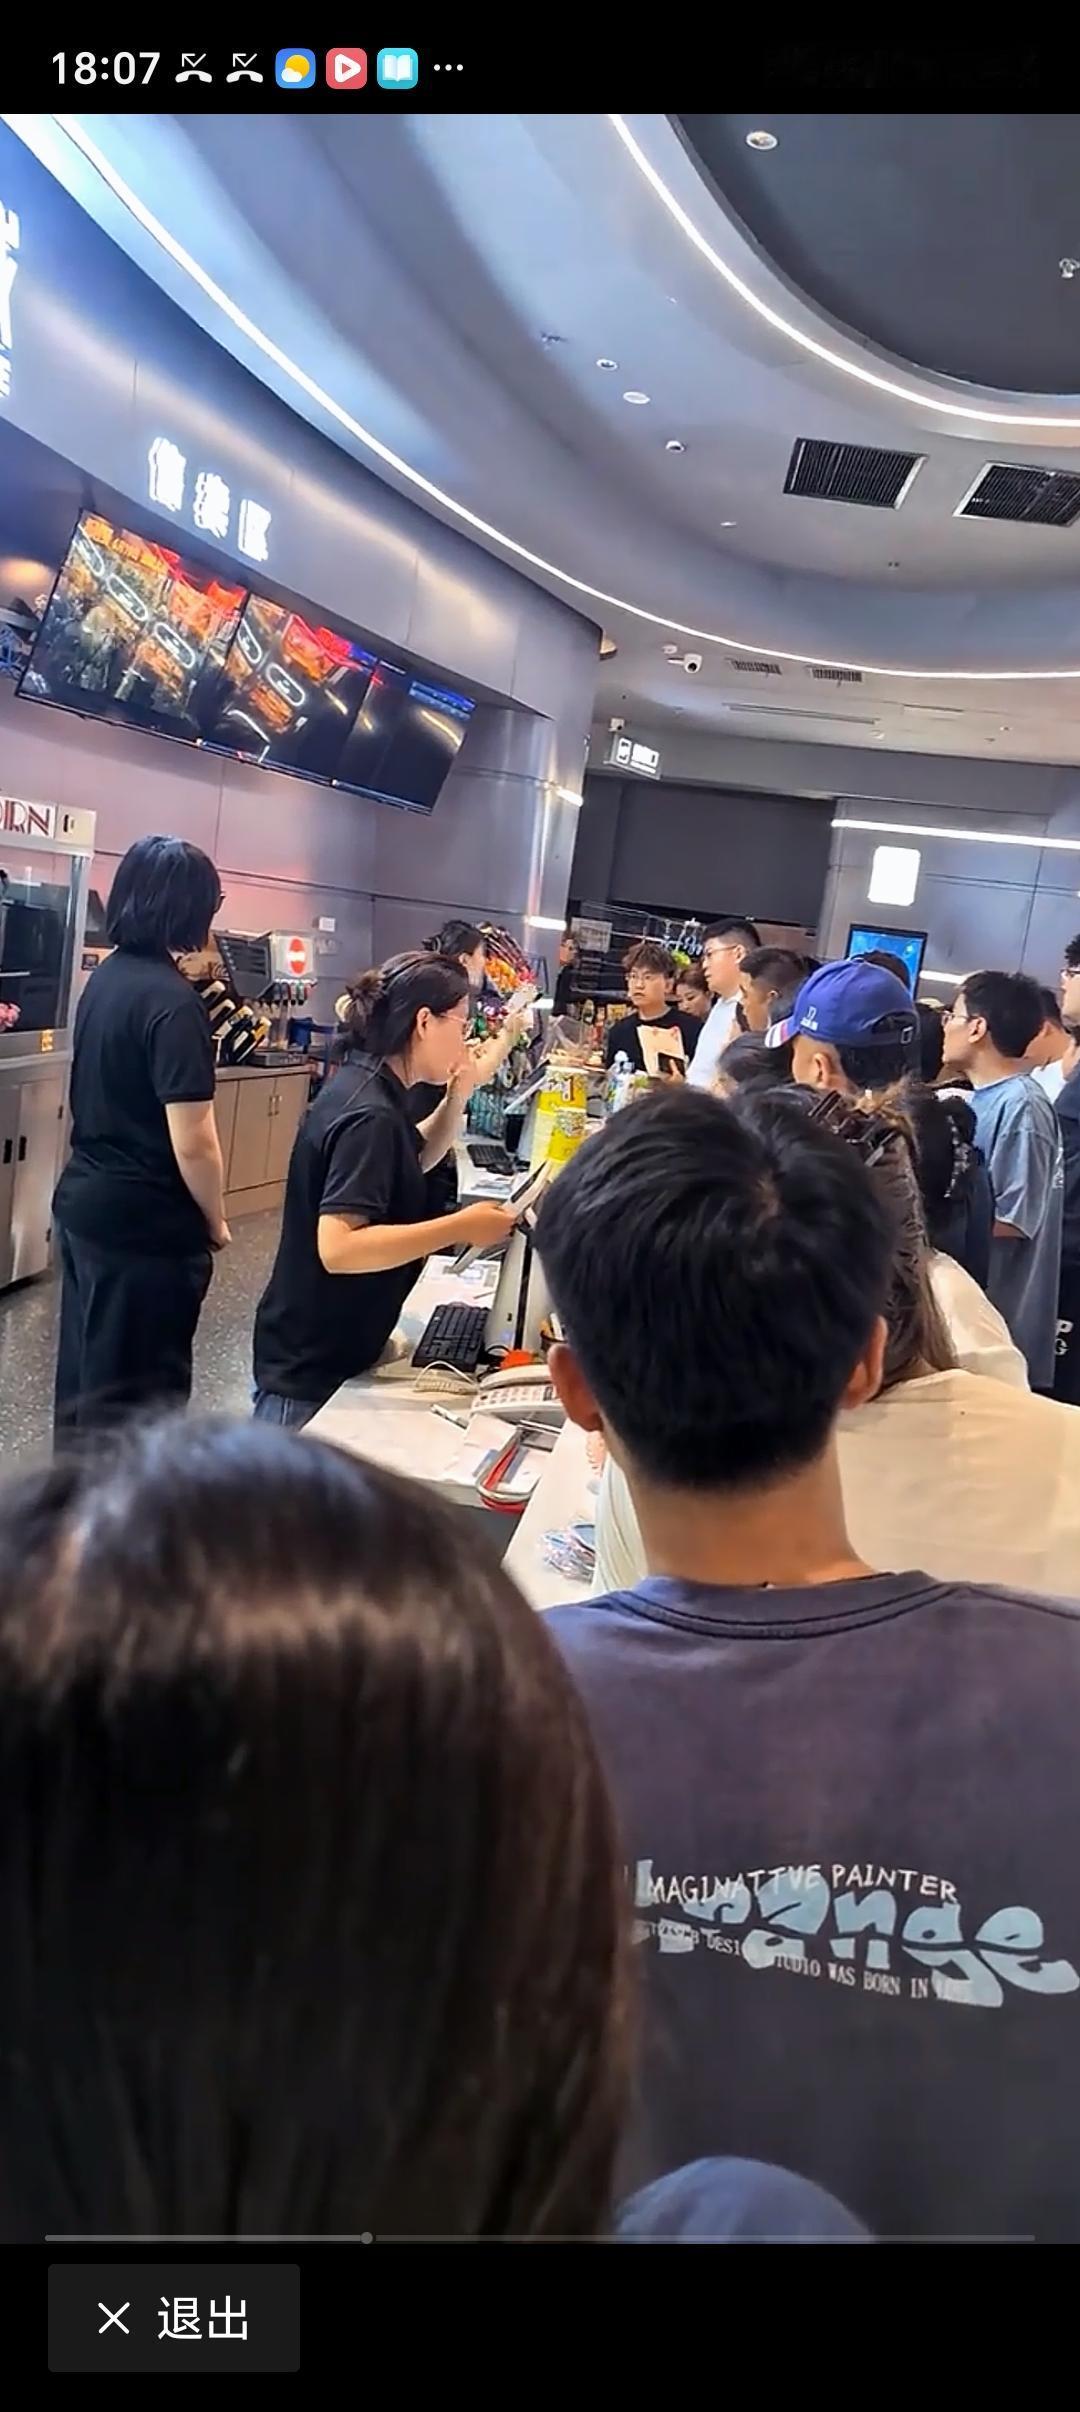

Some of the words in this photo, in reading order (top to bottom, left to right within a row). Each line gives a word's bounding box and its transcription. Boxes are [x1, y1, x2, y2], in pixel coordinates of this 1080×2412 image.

[0, 799, 50, 836] RN
[831, 1863, 958, 1904] PAINTER
[827, 1961, 856, 1987] WAS
[863, 1970, 901, 1996] BORN
[910, 1977, 929, 1998] IN
